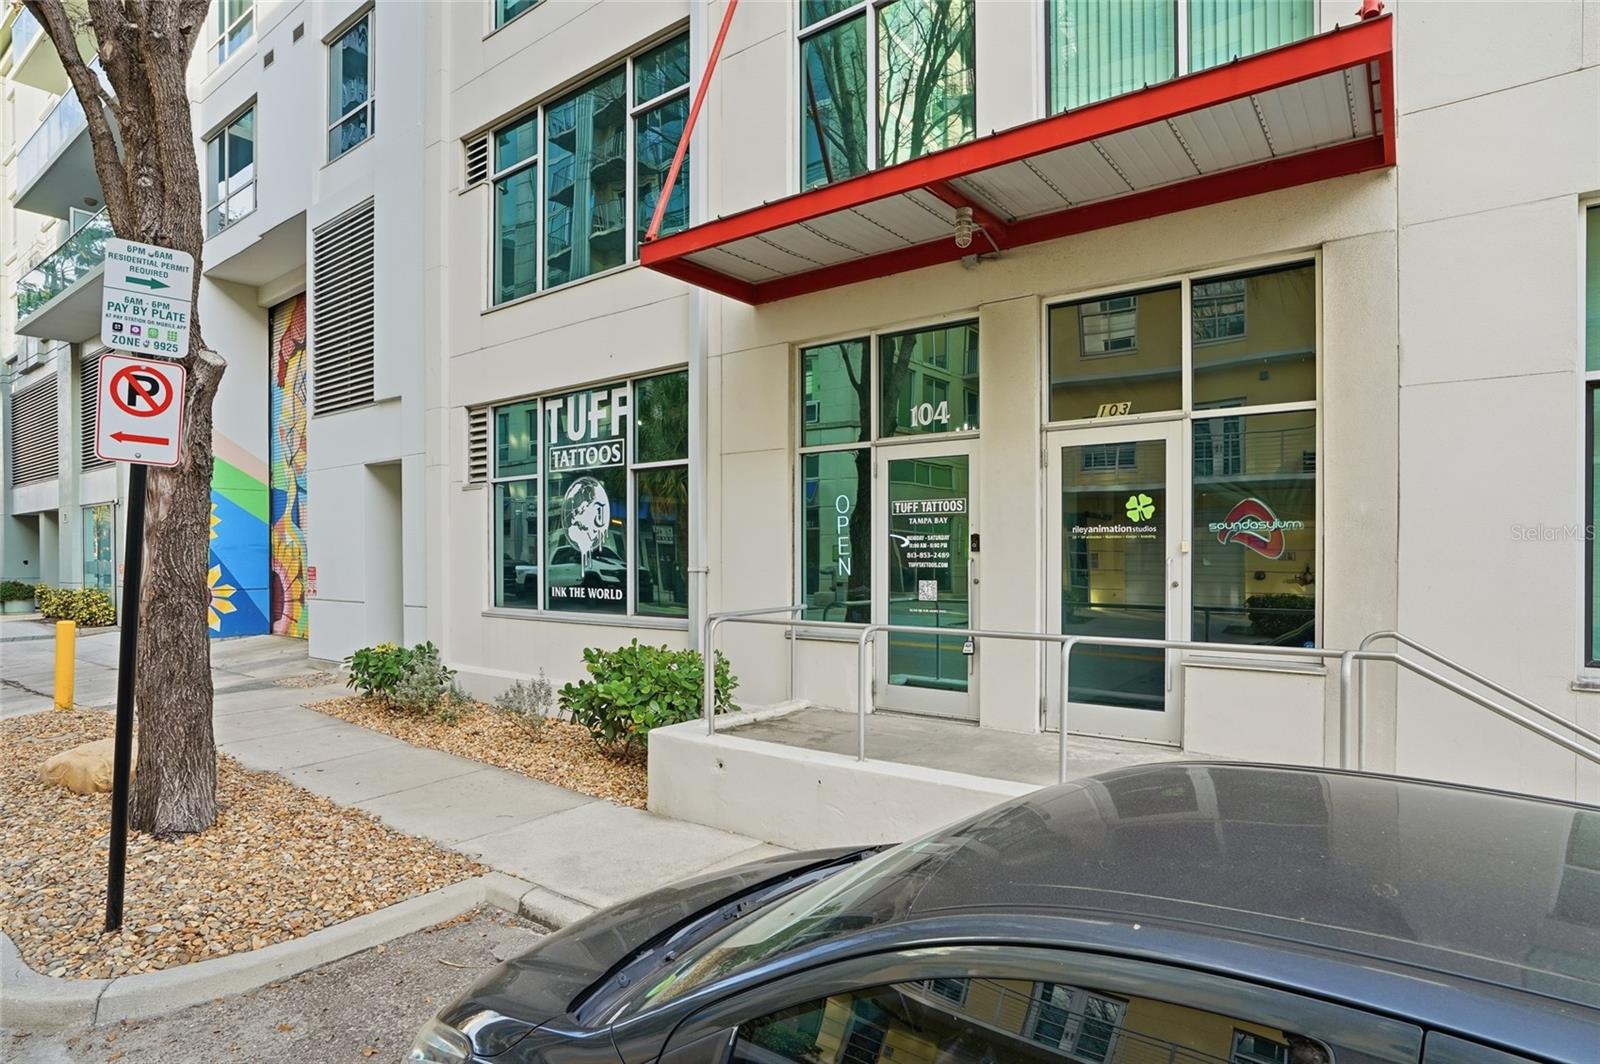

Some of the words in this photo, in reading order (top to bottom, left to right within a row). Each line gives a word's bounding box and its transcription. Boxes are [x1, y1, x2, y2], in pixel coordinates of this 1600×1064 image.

[126, 245, 146, 255] 6PM
[154, 250, 173, 260] 6AM
[108, 252, 158, 267] RESIDENTIAL
[161, 262, 190, 272] PERMIT
[129, 266, 169, 278] REQUIRED
[124, 296, 143, 305] 6AM
[152, 301, 170, 309] 6PM
[107, 301, 128, 313] PAY
[133, 306, 148, 316] BY
[152, 308, 186, 323] PLATE
[112, 335, 140, 347] ZONE
[154, 342, 178, 352] 9925
[544, 387, 627, 444] TUFF
[910, 400, 950, 427] 104
[1100, 403, 1128, 418] 103
[552, 444, 621, 467] TATTOOS
[895, 502, 918, 513] TUFF
[921, 500, 963, 512] TATTOOS
[1209, 519, 1304, 532] soundasylum
[836, 494, 851, 576] OPEN
[552, 586, 567, 597] INK
[569, 587, 585, 598] THE
[588, 588, 623, 600] WORLD
